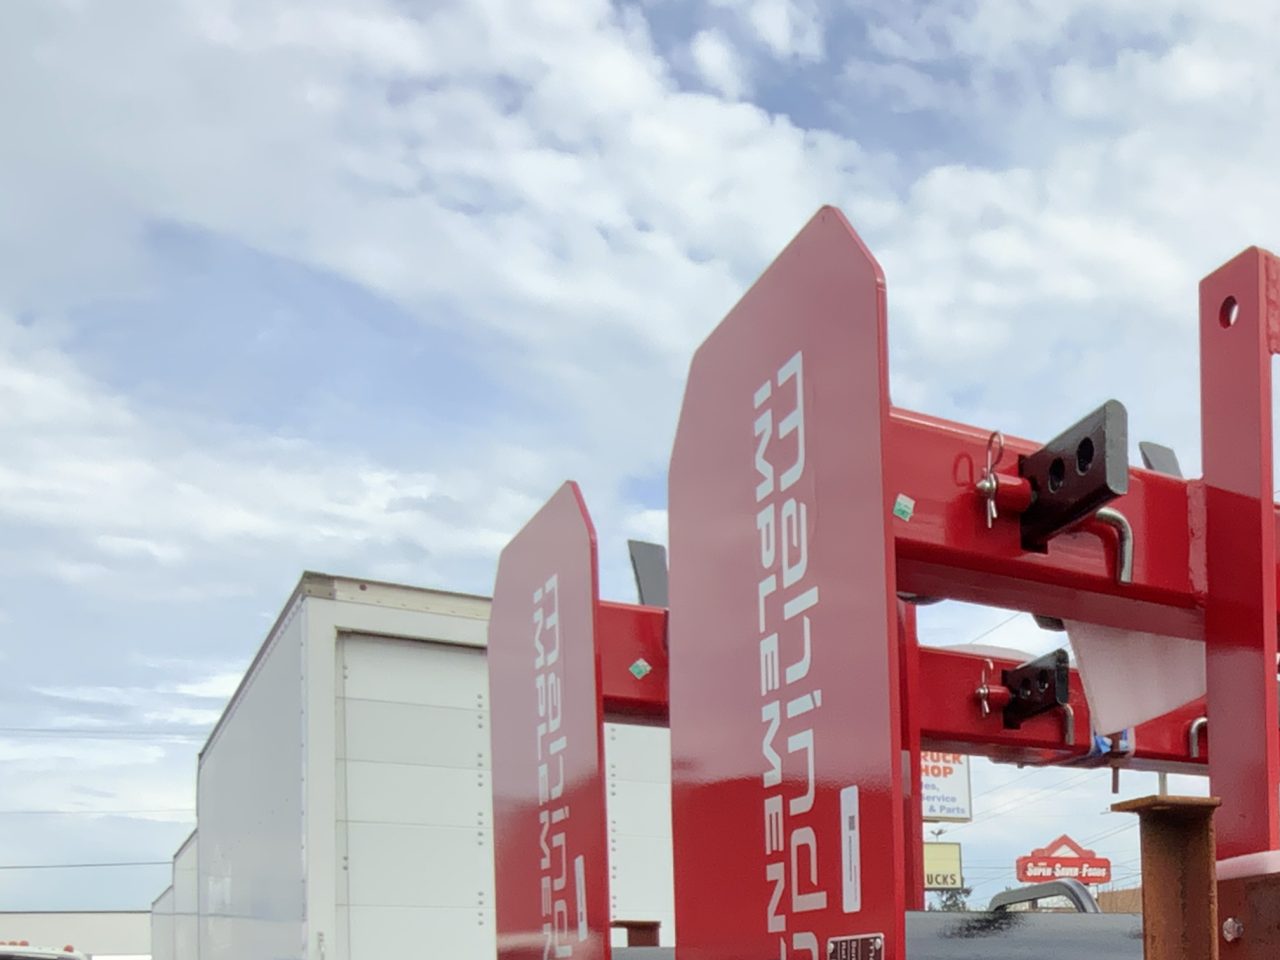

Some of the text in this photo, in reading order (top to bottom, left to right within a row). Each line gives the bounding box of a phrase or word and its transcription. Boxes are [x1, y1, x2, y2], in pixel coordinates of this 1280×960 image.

[921, 751, 963, 764] RUCK
[921, 765, 953, 777] HOP
[926, 873, 957, 886] UCKS
